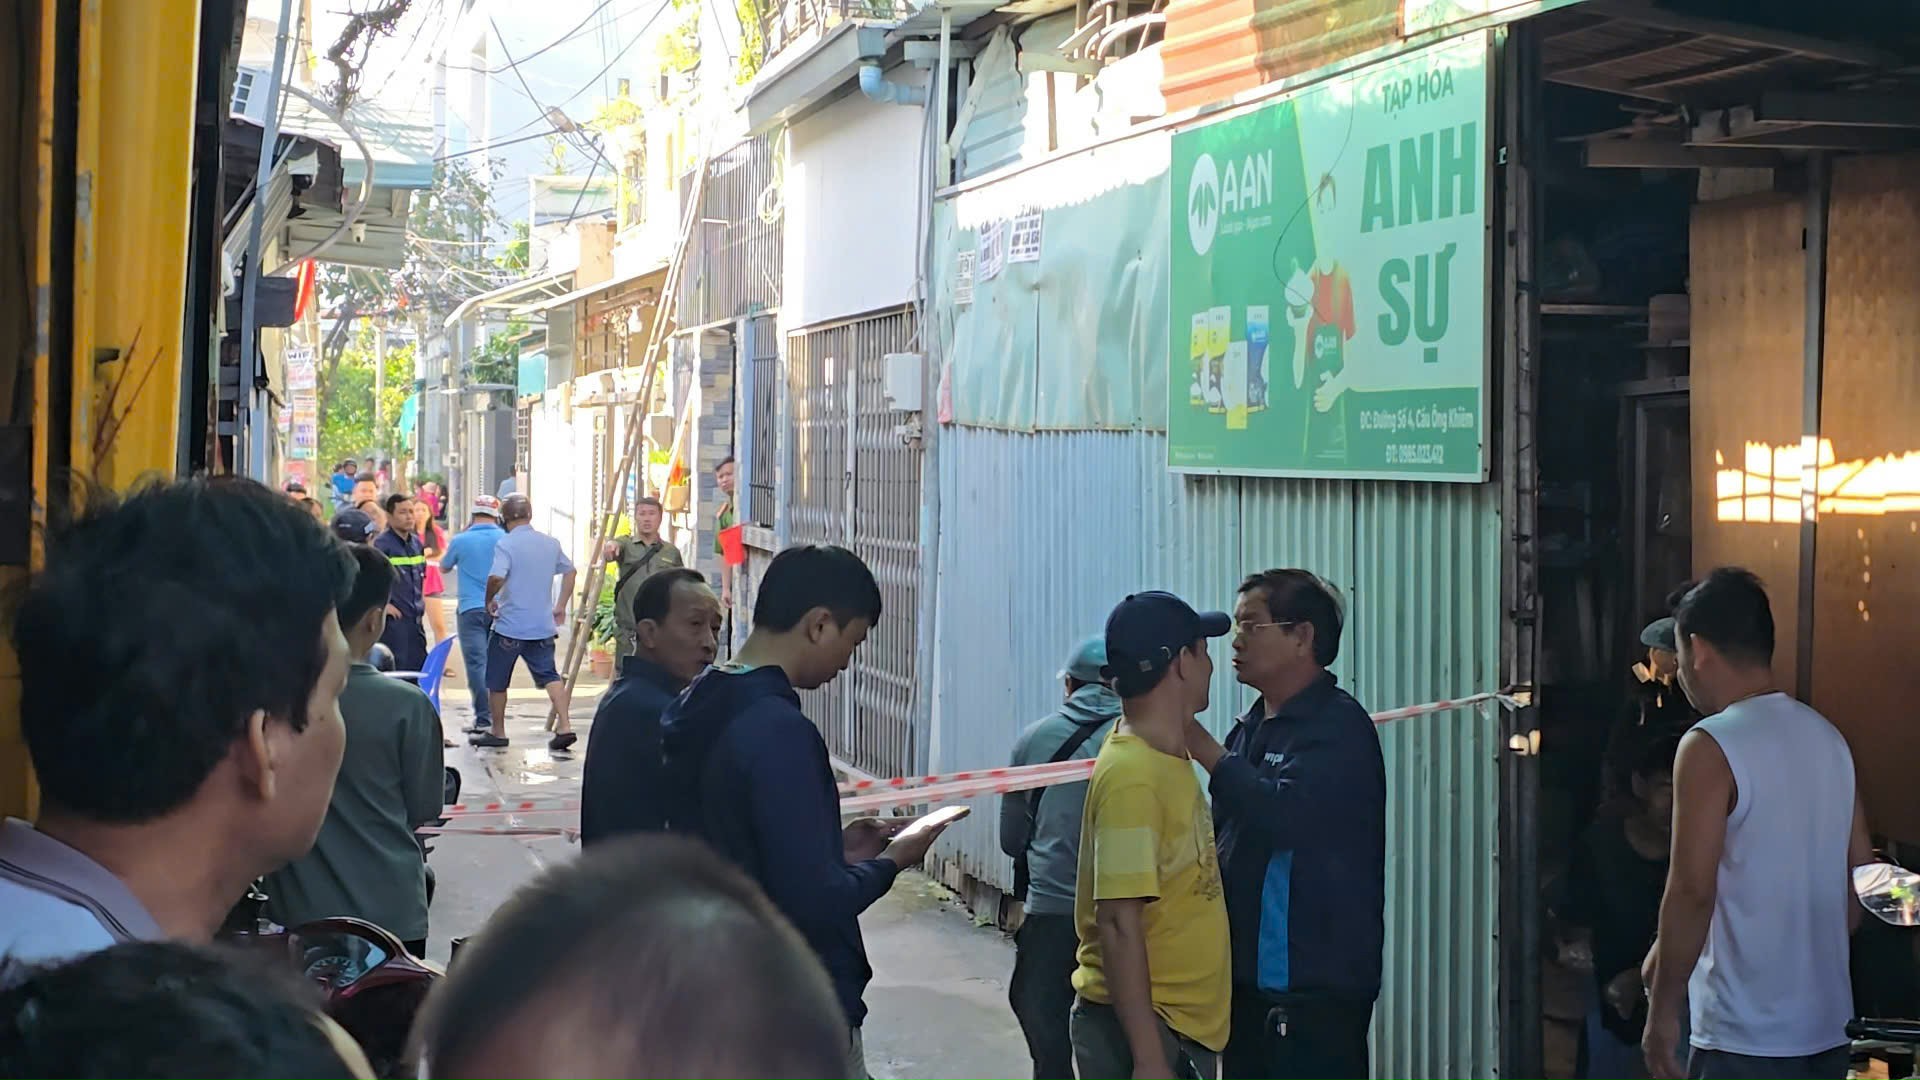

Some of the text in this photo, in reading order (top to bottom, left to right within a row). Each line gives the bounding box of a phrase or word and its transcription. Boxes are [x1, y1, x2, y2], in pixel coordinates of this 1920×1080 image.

[1381, 60, 1454, 119] TẠP HÓA
[1222, 149, 1272, 215] AAN
[1360, 122, 1477, 233] ANH
[1377, 242, 1457, 363] SỰ
